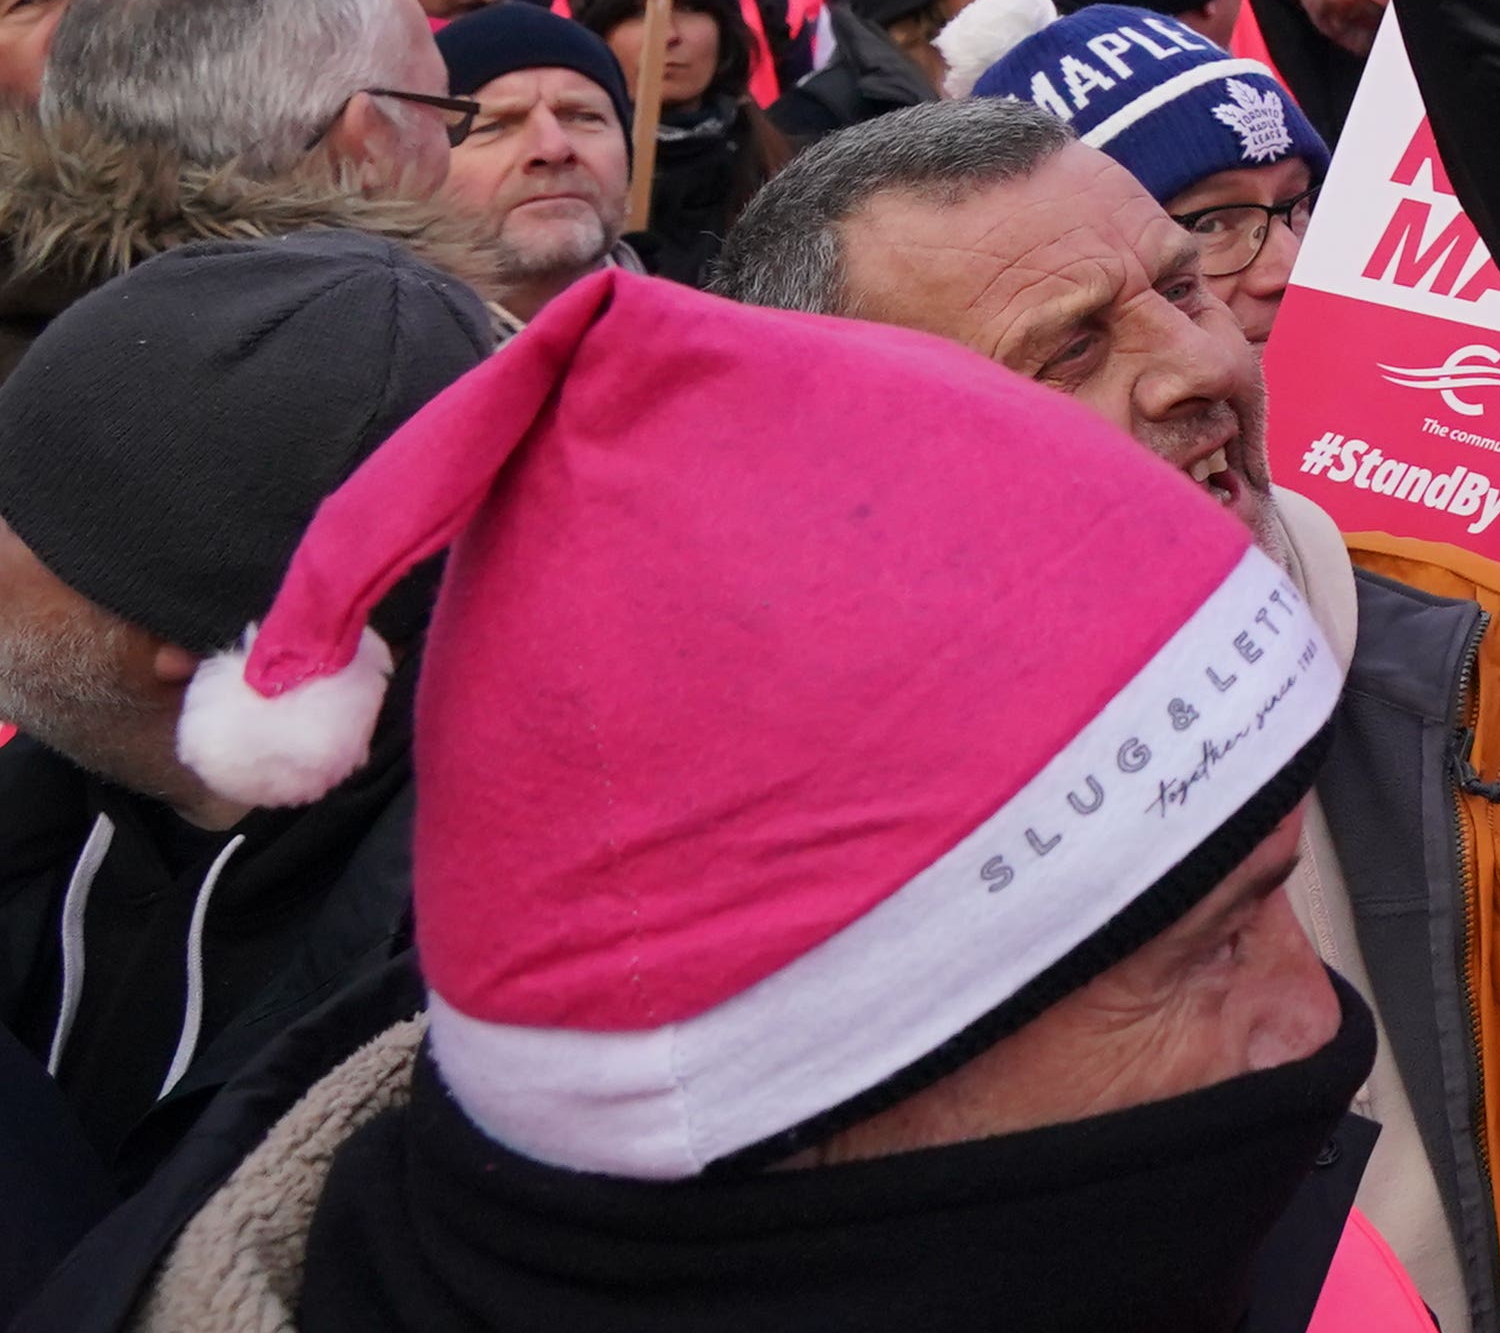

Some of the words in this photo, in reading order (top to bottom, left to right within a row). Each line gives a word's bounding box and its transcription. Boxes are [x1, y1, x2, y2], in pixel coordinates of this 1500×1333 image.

[1237, 107, 1279, 128] TORONTO
[1421, 417, 1452, 440] The
[1143, 725, 1251, 819] together
[1253, 671, 1298, 730] since
[979, 737, 1154, 894] SLUG
[1167, 697, 1201, 732] &
